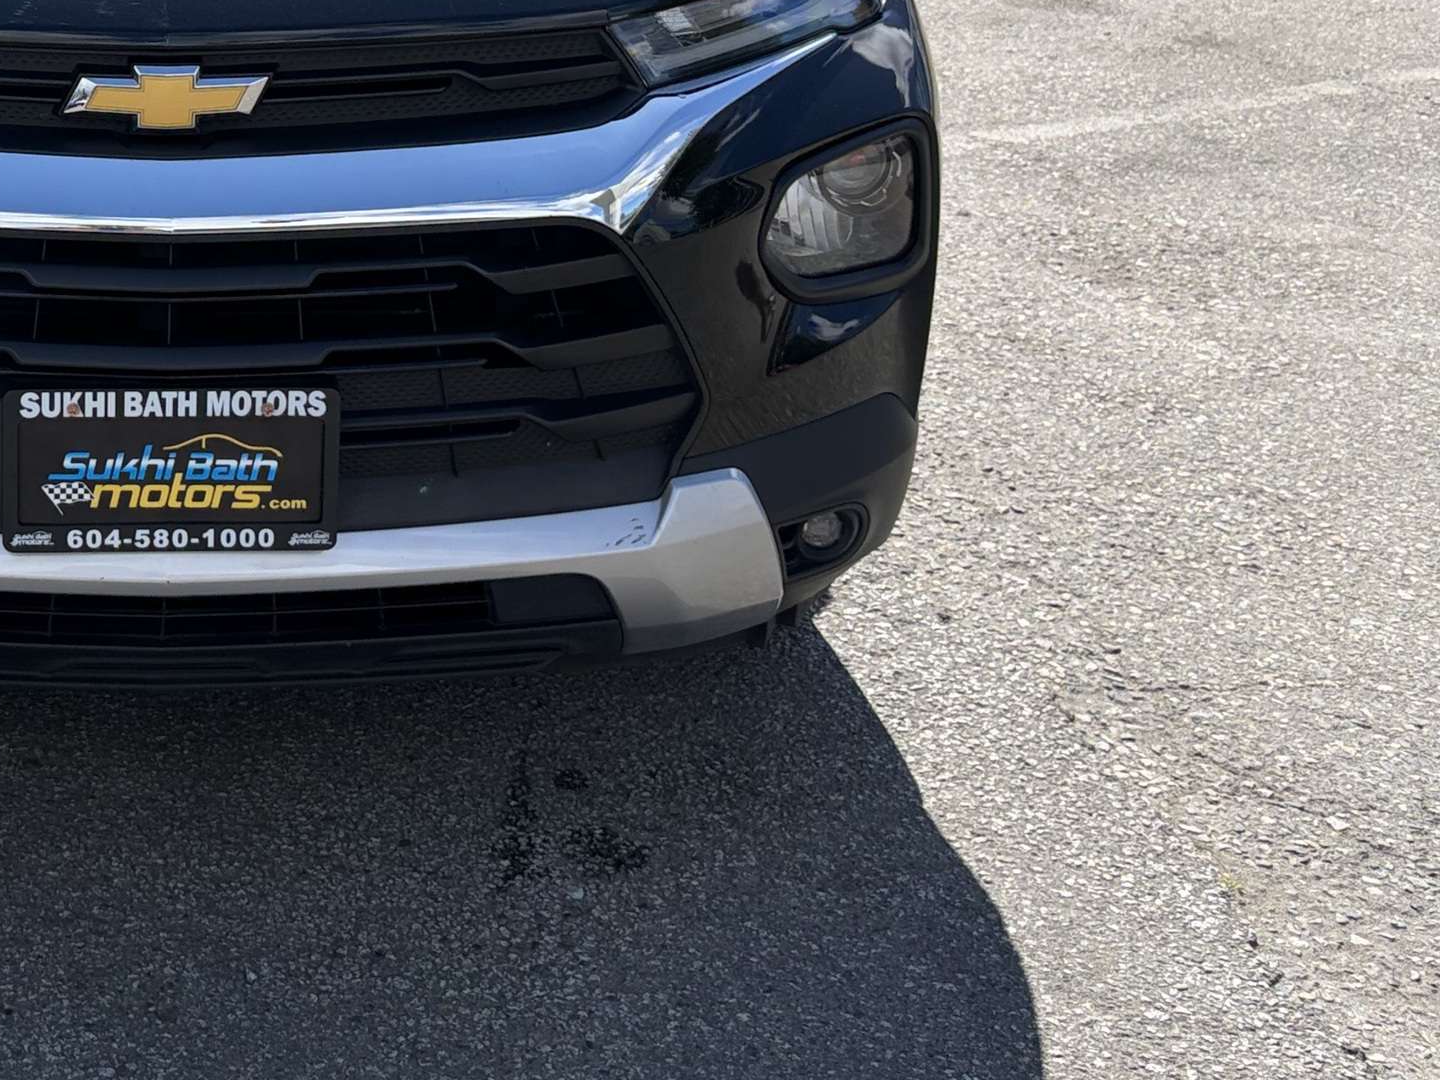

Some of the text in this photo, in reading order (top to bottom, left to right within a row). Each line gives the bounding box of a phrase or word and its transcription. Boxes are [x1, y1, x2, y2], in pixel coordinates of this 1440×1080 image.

[19, 390, 327, 419] SUKHI BATH MOTORS
[48, 444, 279, 482] Sukhi Bath
[66, 528, 275, 549] 604-580-1000
